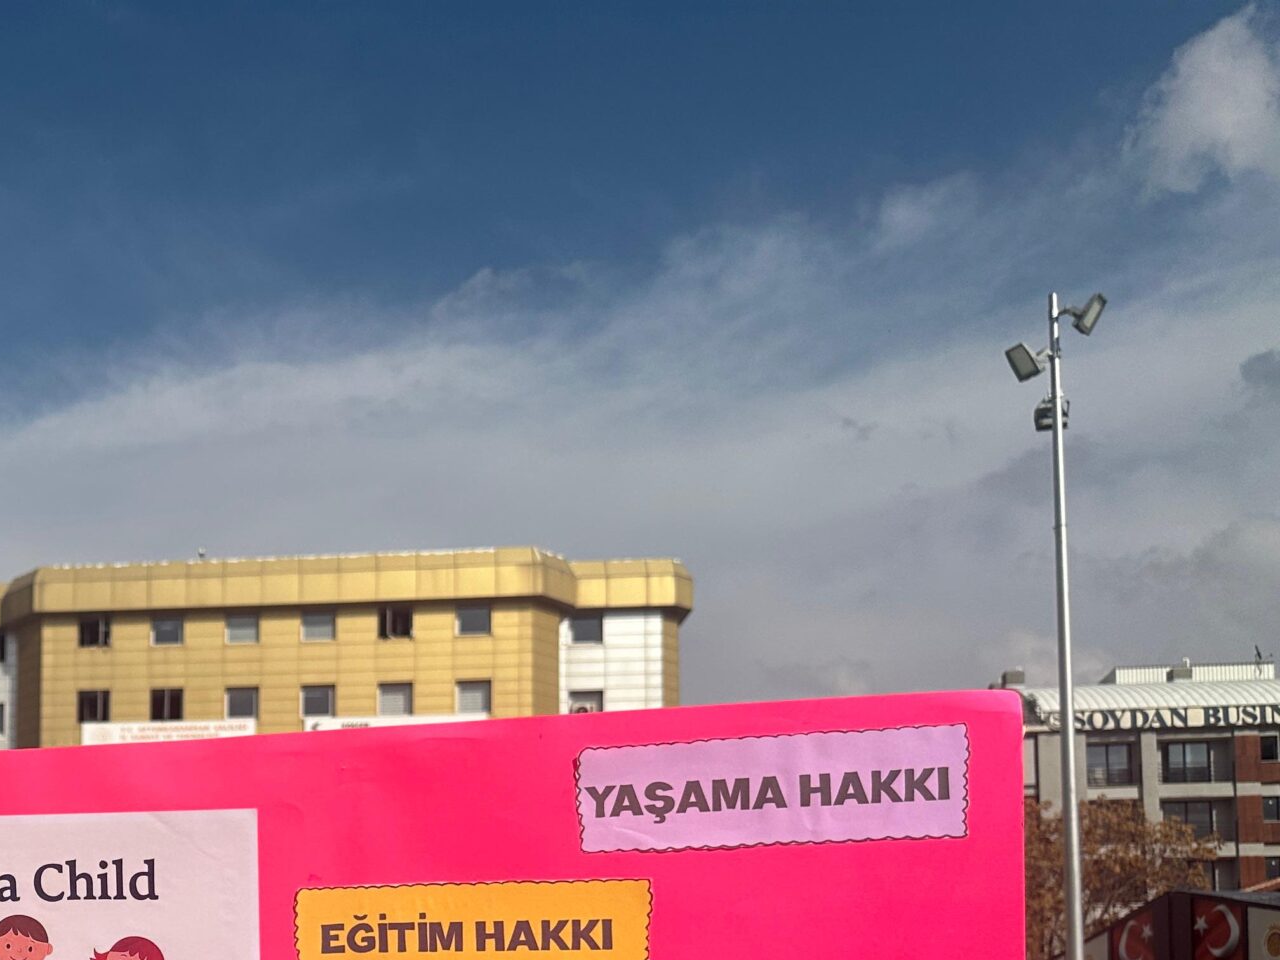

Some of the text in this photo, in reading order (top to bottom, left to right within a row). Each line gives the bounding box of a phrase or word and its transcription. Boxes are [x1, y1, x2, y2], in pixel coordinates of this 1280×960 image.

[1073, 707, 1188, 730] SOYDAN
[583, 766, 951, 824] YAŞAMA HAKKI
[33, 858, 159, 902] Child
[319, 912, 614, 955] EĞİTİM HAKKI
